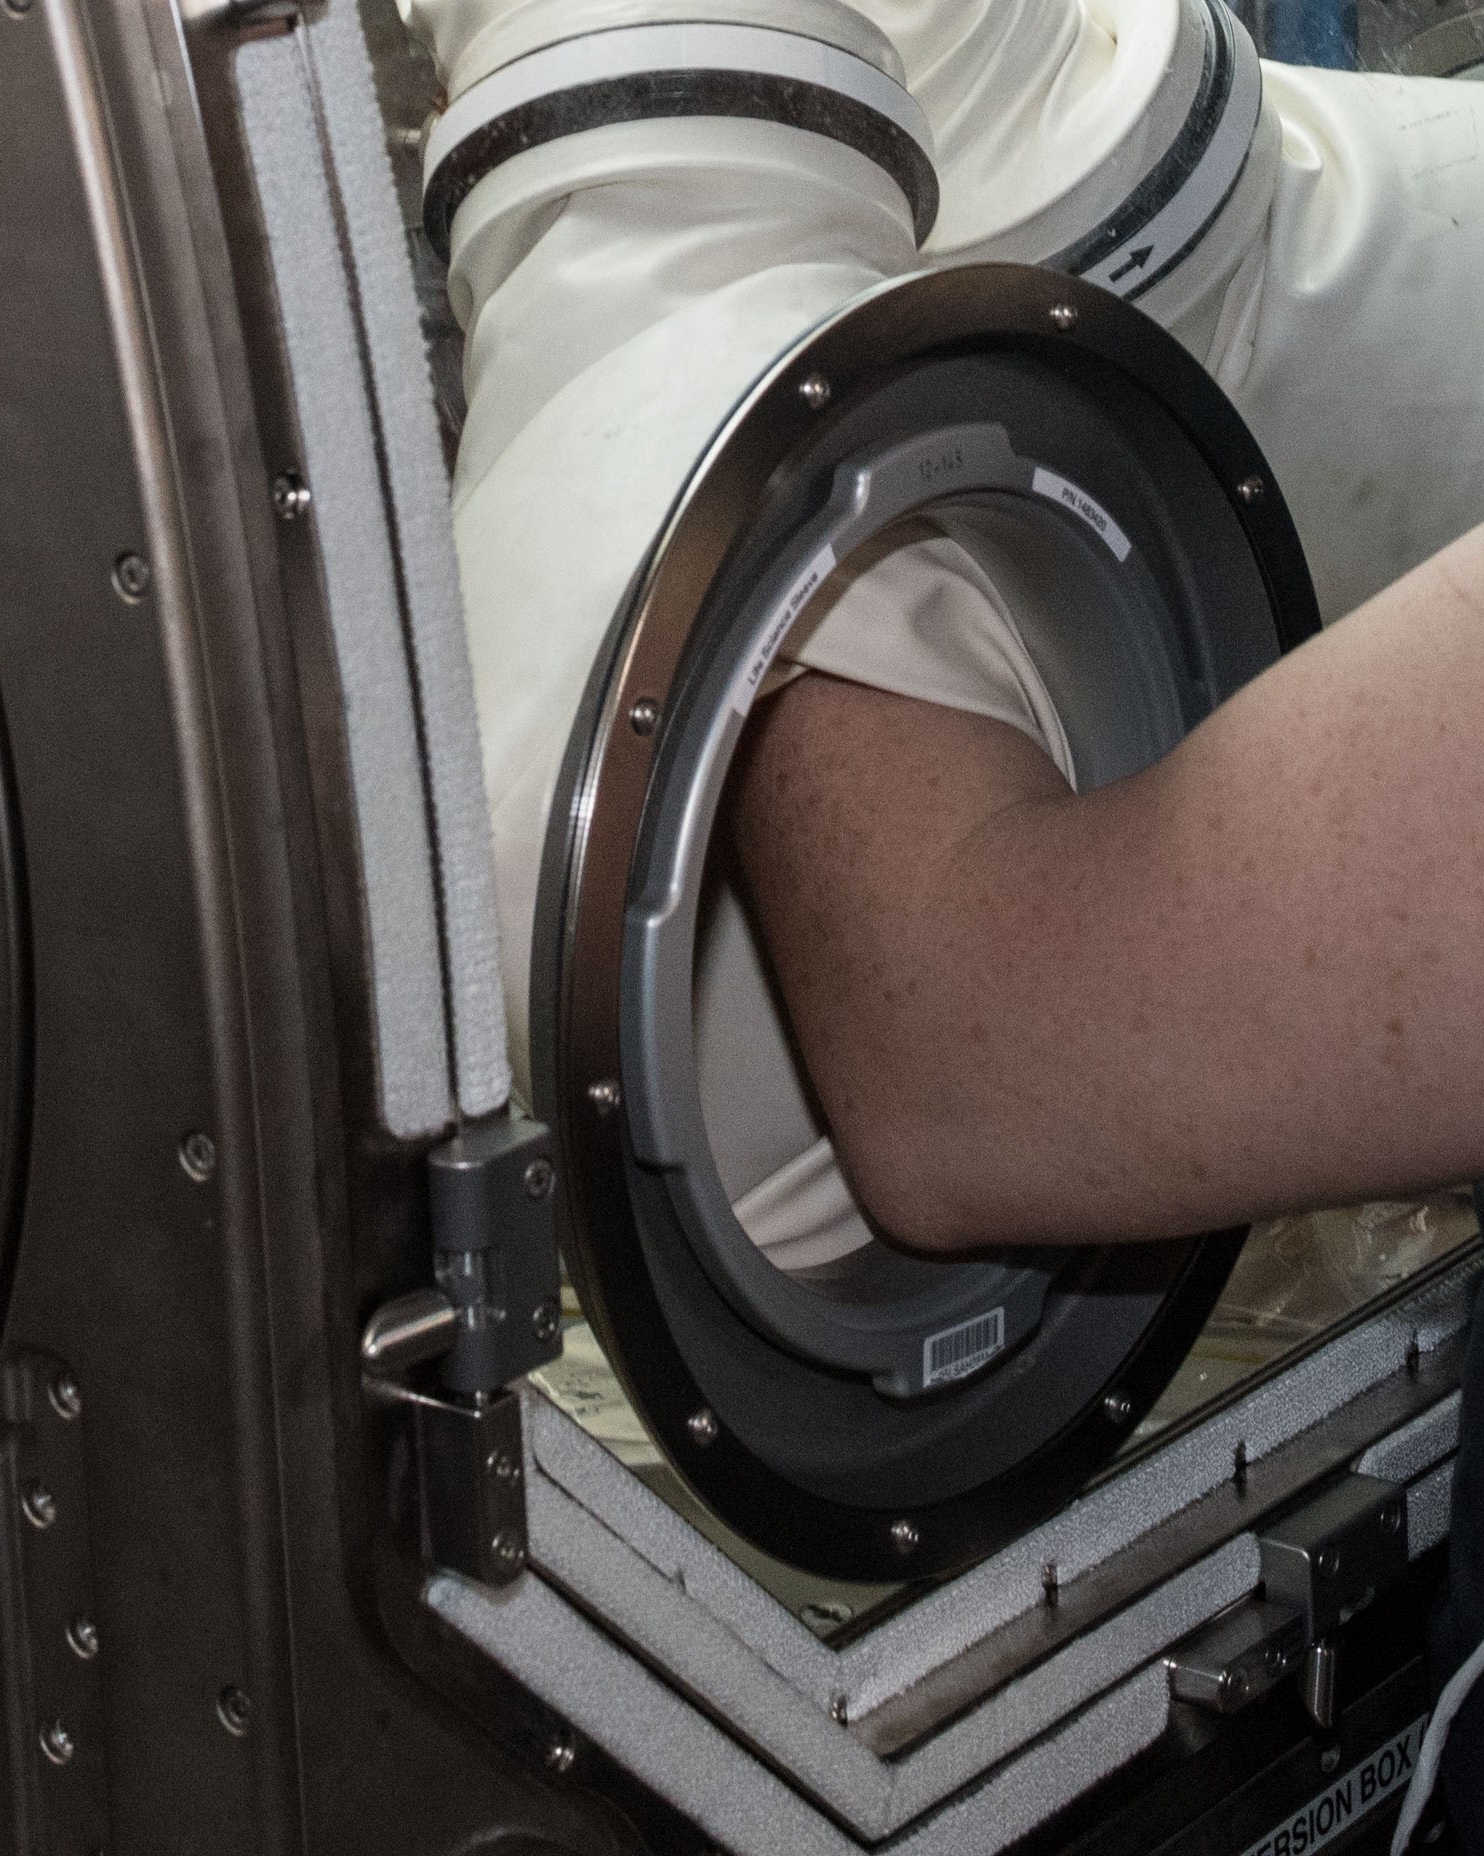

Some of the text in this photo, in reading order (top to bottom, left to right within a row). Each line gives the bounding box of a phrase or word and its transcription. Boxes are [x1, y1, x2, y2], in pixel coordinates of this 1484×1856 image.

[747, 661, 767, 687] Life
[762, 605, 792, 663] Science
[1256, 1780, 1353, 1856] ERSION
[1360, 1735, 1412, 1805] BOX
